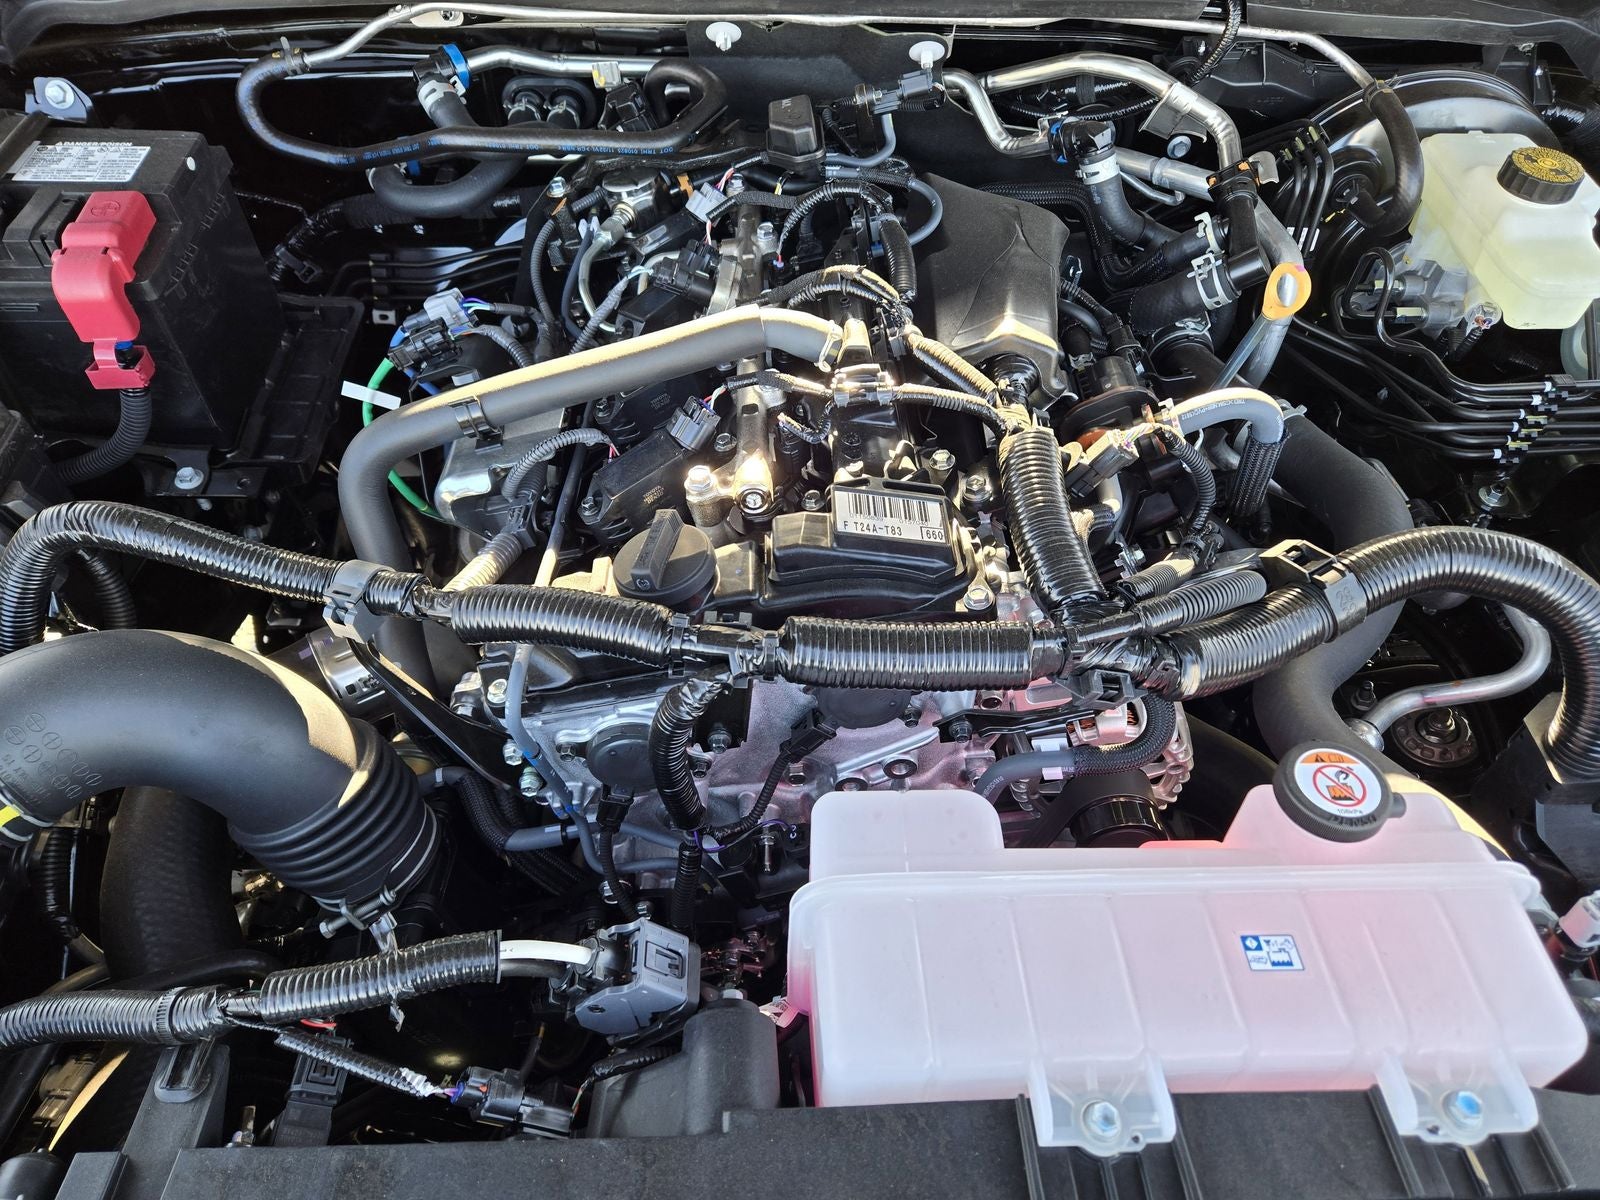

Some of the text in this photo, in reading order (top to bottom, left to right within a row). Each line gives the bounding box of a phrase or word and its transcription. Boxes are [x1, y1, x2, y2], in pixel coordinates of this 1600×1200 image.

[843, 520, 903, 537] F T24A-T83
[925, 529, 944, 541] 660
